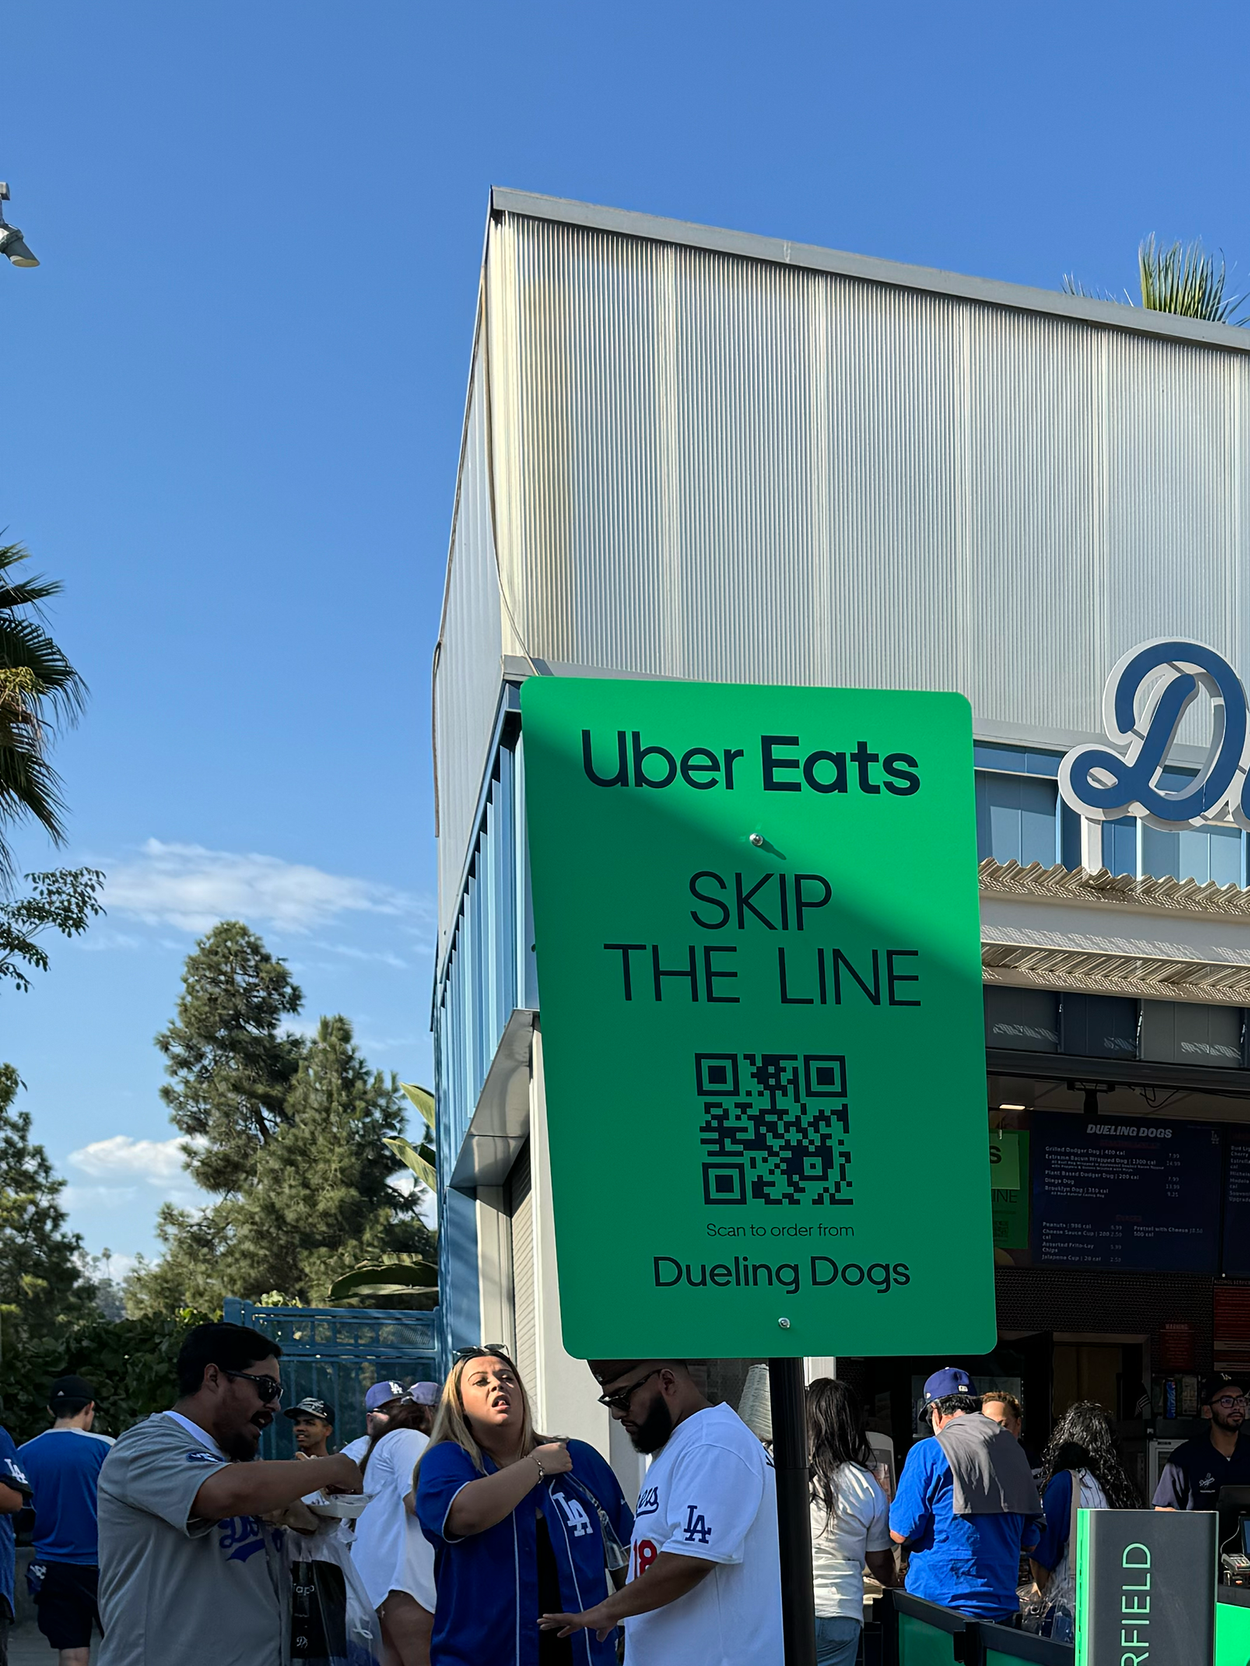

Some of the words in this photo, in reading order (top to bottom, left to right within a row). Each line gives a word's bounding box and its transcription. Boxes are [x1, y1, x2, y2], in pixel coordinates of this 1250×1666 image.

[582, 729, 744, 790] Uber
[760, 735, 921, 796] Eats
[689, 871, 832, 932] SKIP
[603, 943, 741, 1003] THE
[780, 947, 921, 1006] LINE
[1087, 1124, 1137, 1136] DUELING
[1139, 1127, 1172, 1138] DOGS
[992, 1189, 1017, 1203] INE
[706, 1223, 746, 1237] Scan
[750, 1225, 766, 1237] to
[771, 1223, 813, 1237] order
[817, 1223, 854, 1237] from
[653, 1256, 800, 1294] Dueling
[810, 1256, 910, 1293] Dogs
[683, 1505, 712, 1544] LA
